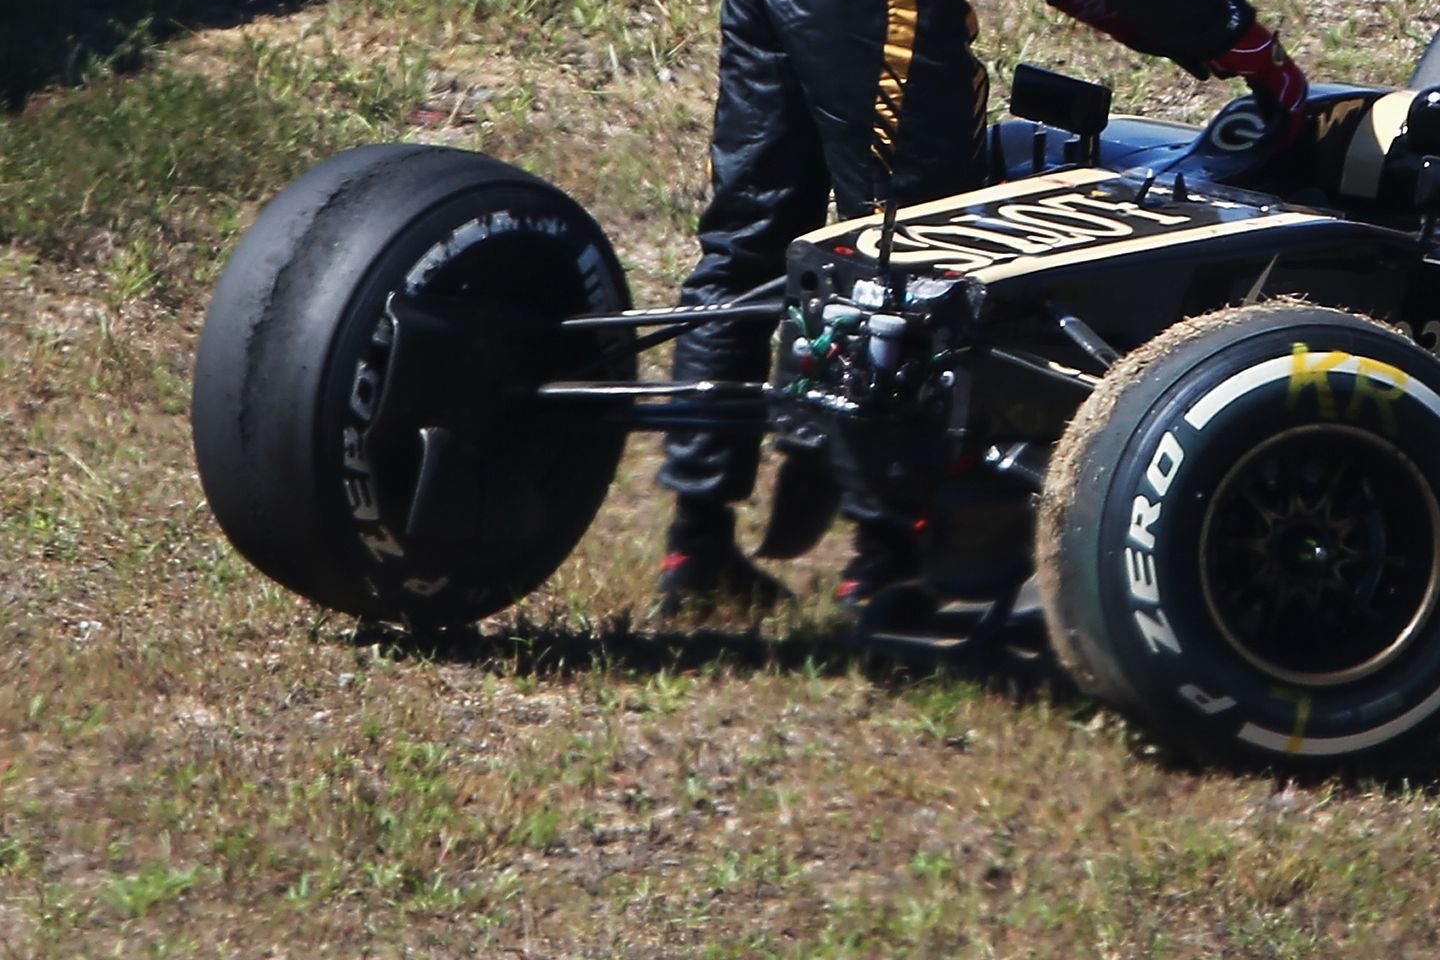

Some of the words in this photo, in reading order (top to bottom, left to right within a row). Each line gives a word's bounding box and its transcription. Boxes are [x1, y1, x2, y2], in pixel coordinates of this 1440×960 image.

[856, 190, 1193, 273] LOTUS
[1125, 430, 1187, 655] ZERO
[1179, 682, 1238, 715] P
